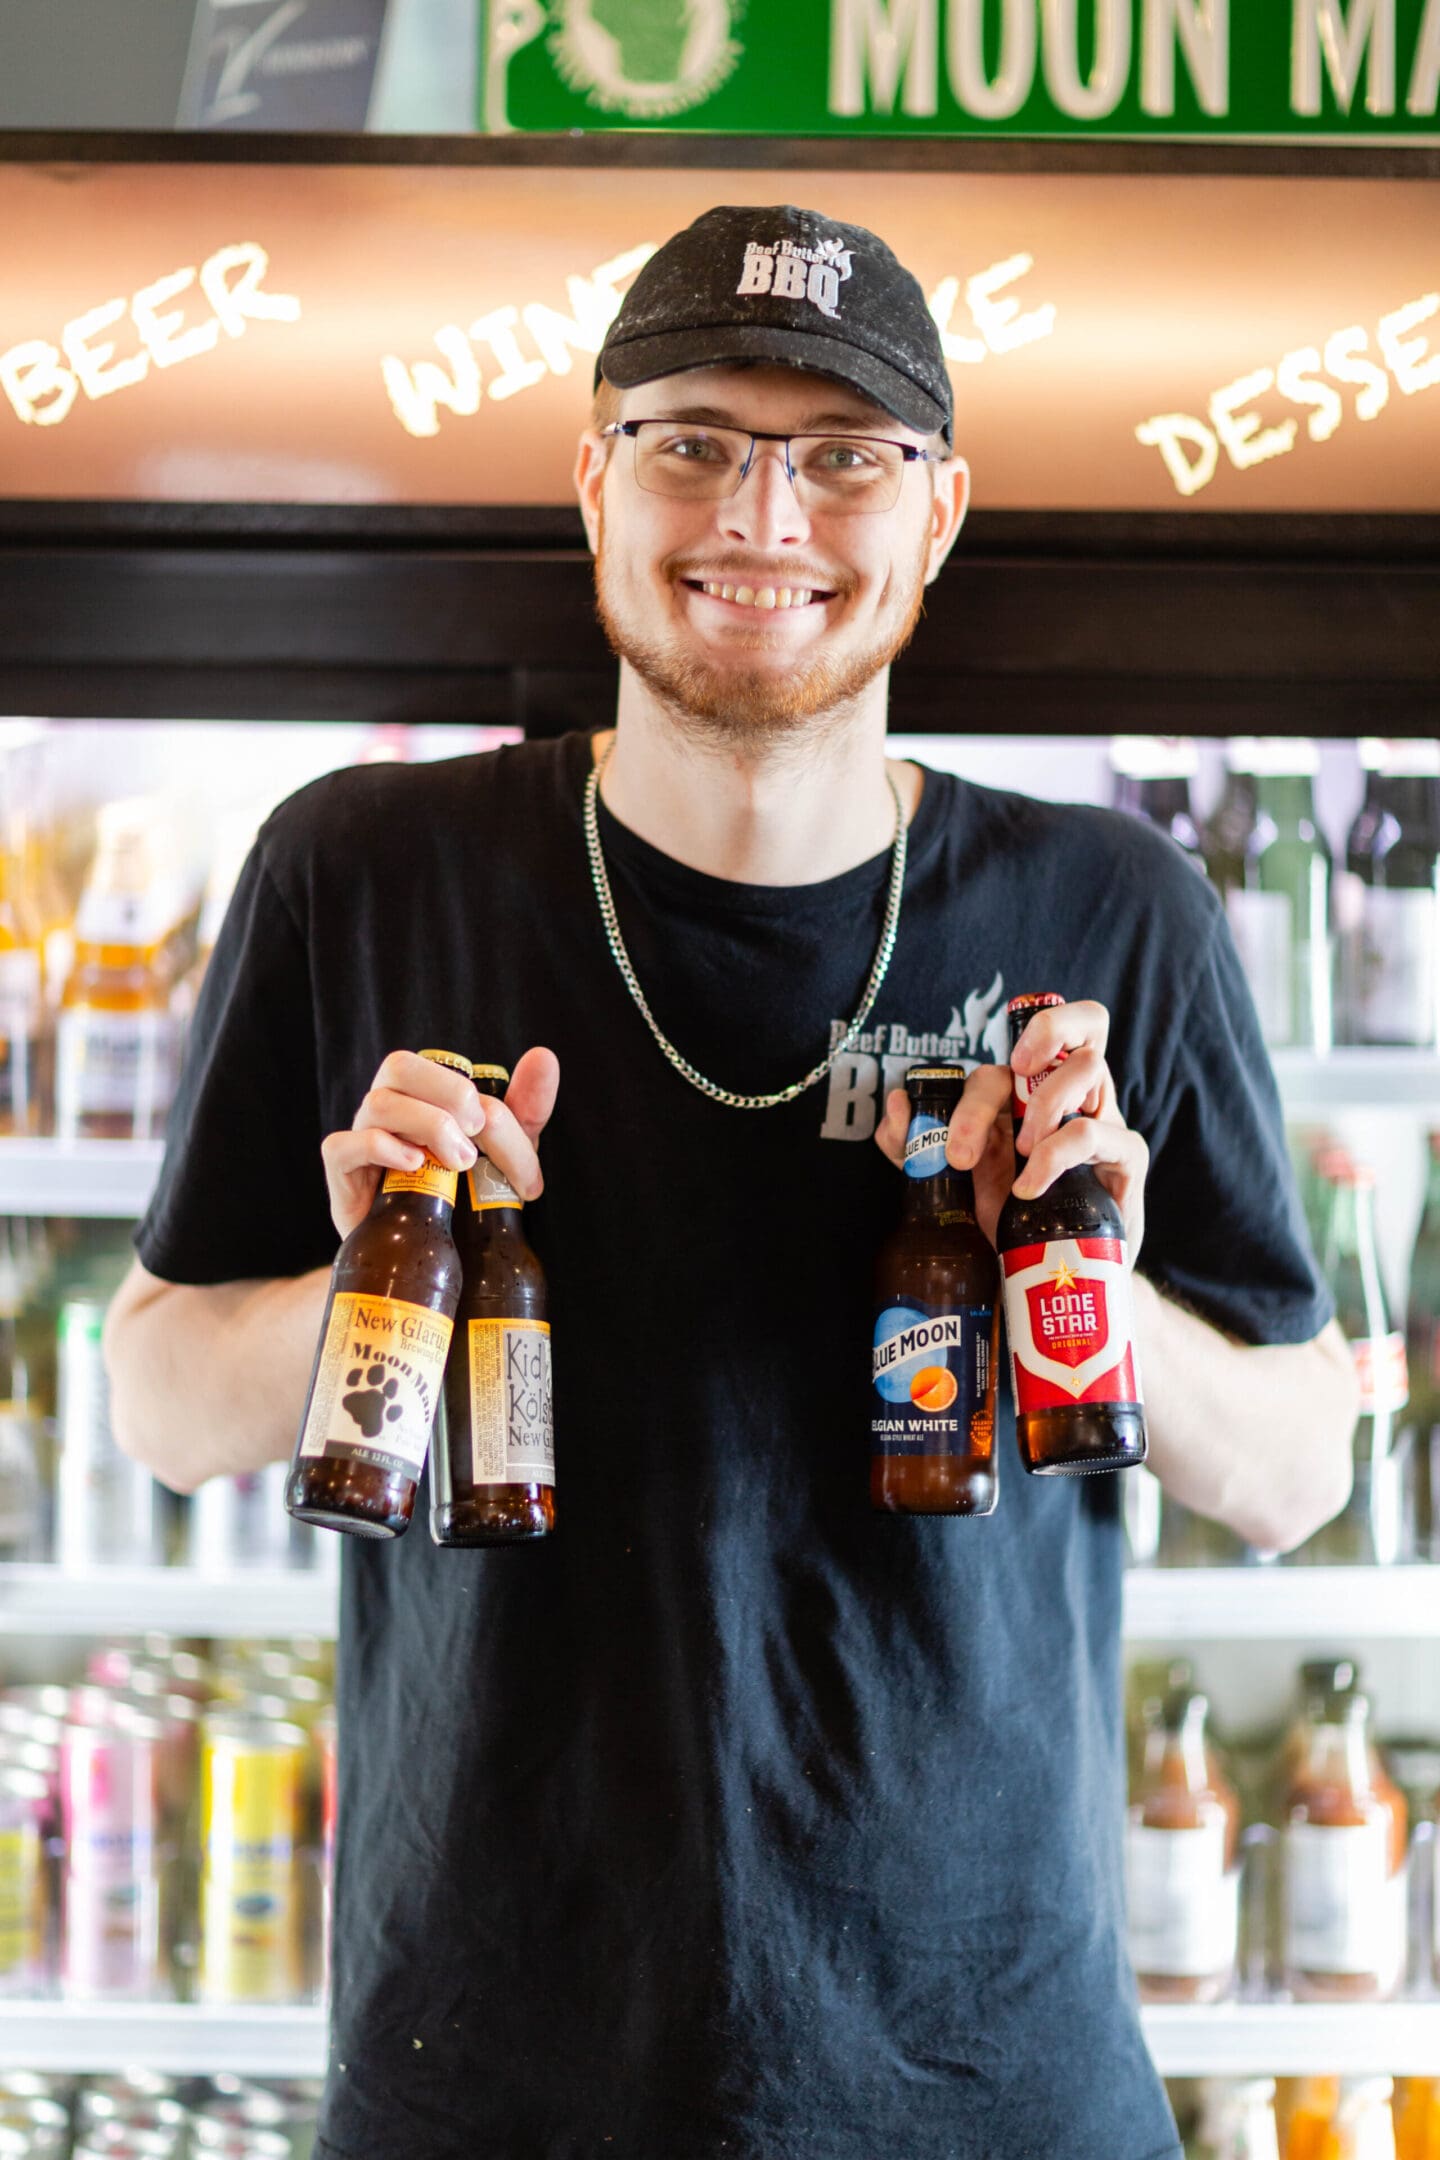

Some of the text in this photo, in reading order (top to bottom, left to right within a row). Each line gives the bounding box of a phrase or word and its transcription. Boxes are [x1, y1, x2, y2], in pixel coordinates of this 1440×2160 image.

[827, 0, 1232, 120] MOON
[736, 254, 842, 320] BBQ
[0, 241, 300, 426] BEER
[890, 1024, 966, 1057] Butter
[922, 1131, 949, 1148] MOO
[1040, 1293, 1096, 1316] LONE
[1042, 1313, 1098, 1335] STAR
[354, 1307, 397, 1333] New
[401, 1316, 447, 1353] Glarus
[873, 1321, 957, 1371] LUE MOON
[1052, 1338, 1091, 1349] ORIGINAL
[507, 1332, 542, 1388] Kid
[350, 1342, 431, 1423] Moon Man
[508, 1426, 541, 1447] New
[872, 1419, 958, 1432] ELGIAN WHITE
